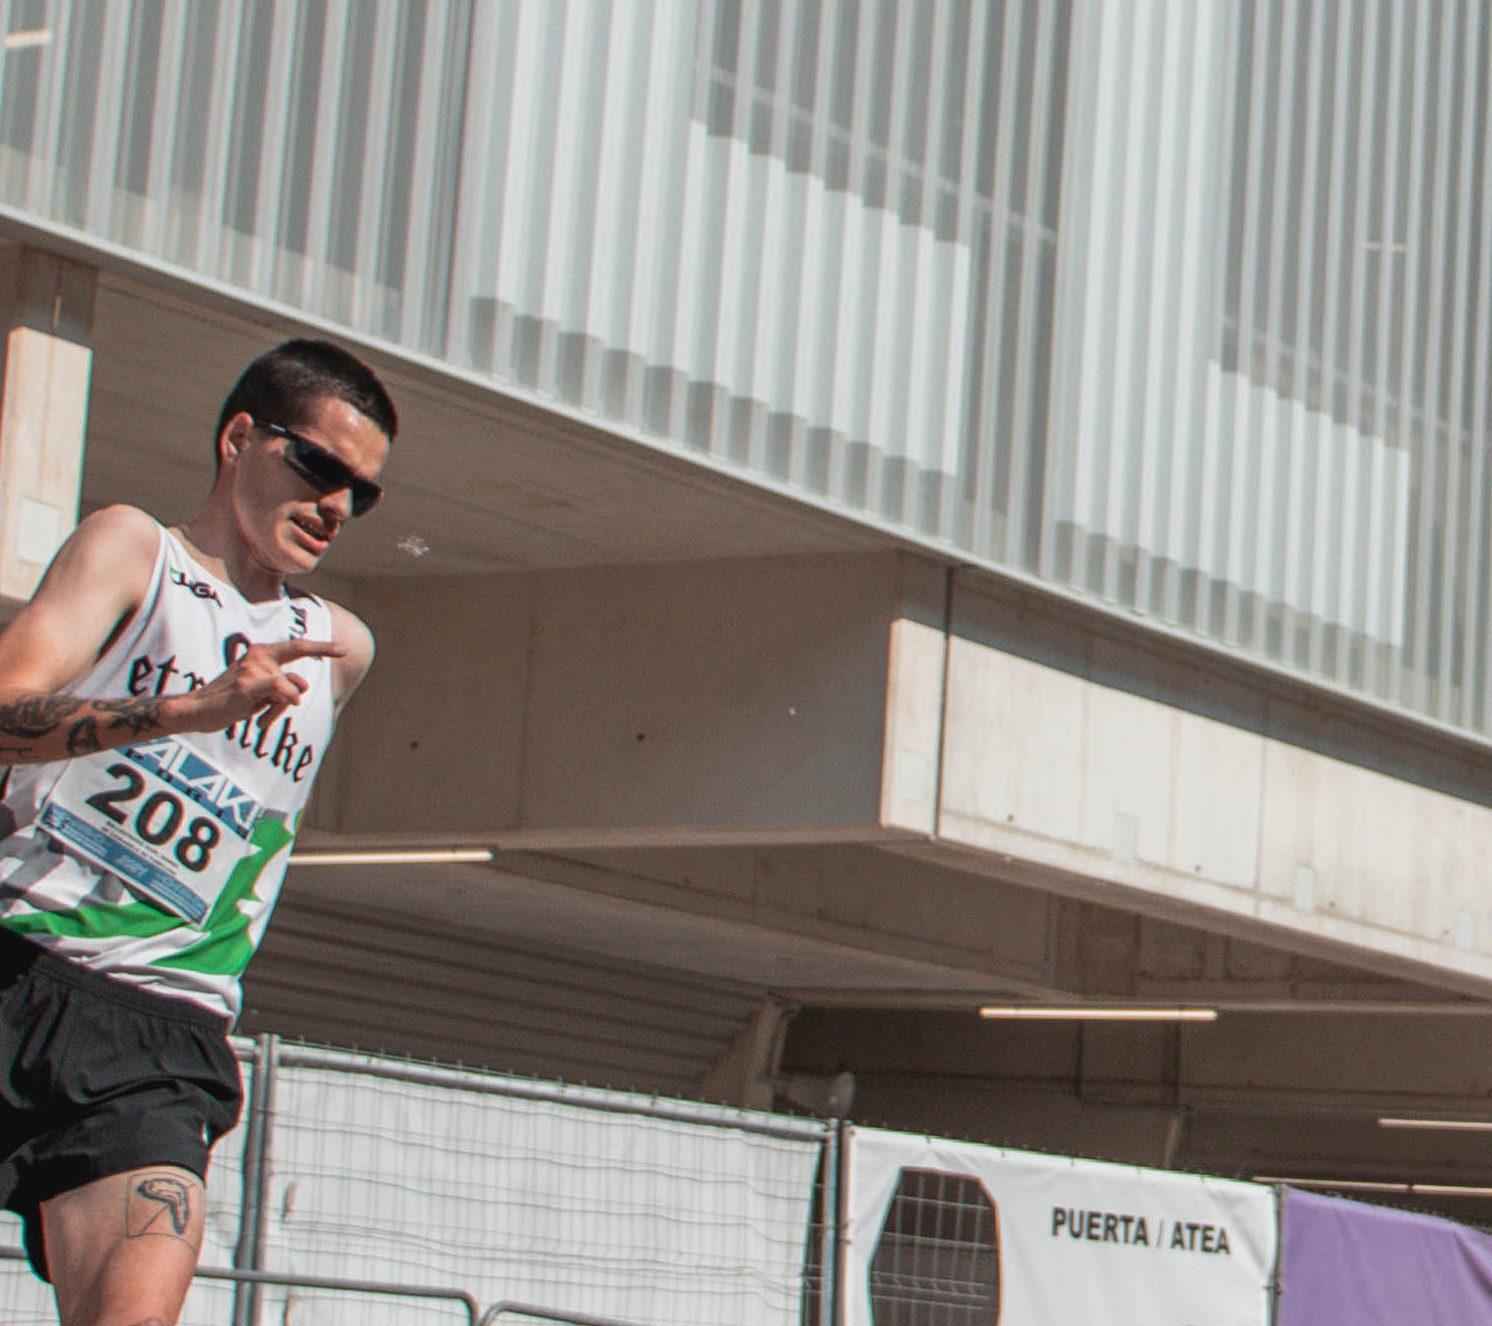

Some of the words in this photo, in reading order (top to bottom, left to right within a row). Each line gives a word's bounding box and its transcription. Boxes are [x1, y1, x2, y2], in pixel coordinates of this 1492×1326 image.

[85, 762, 221, 874] 208
[1052, 1206, 1150, 1247] PUERTA
[1170, 1221, 1232, 1255] ATEA
